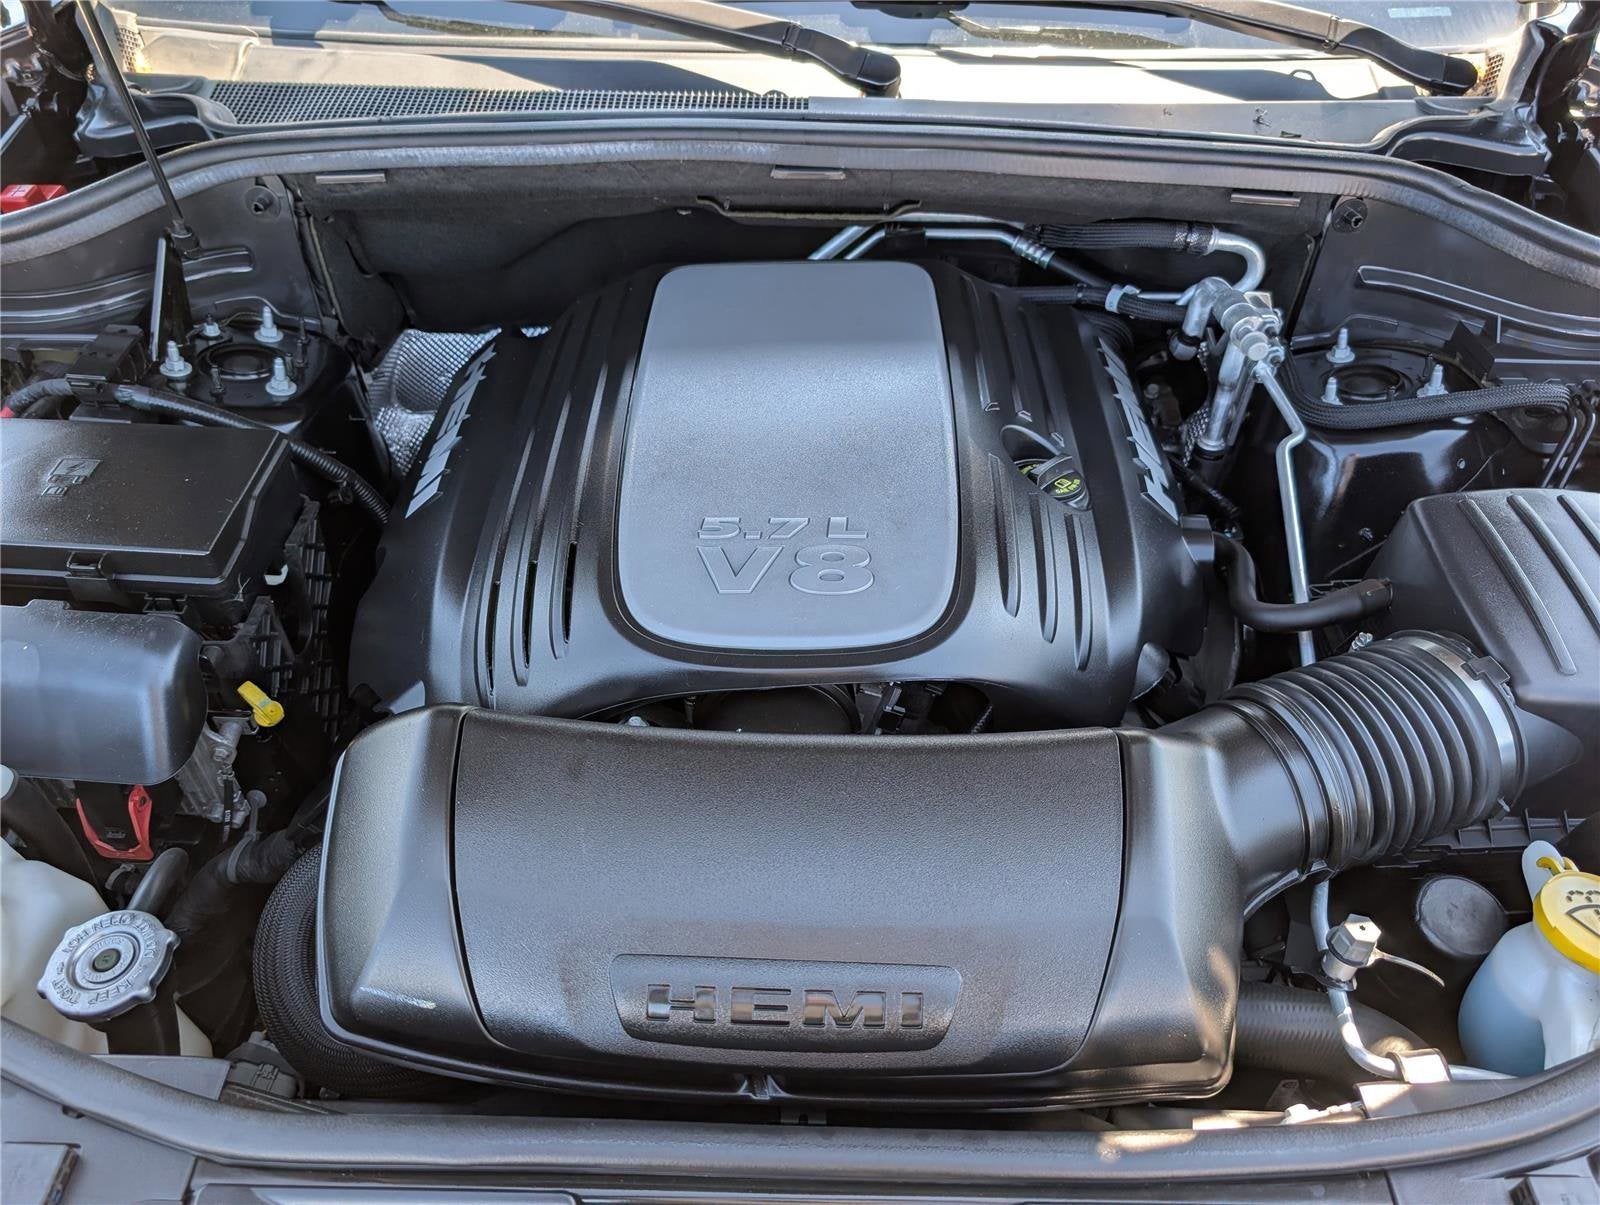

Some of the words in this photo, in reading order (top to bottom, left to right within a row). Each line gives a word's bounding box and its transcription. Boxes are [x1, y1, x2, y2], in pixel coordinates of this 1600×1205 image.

[404, 342, 498, 519] HEMI
[1097, 336, 1180, 526] HEMI
[696, 544, 875, 595] V8
[646, 983, 924, 1030] HEMI
